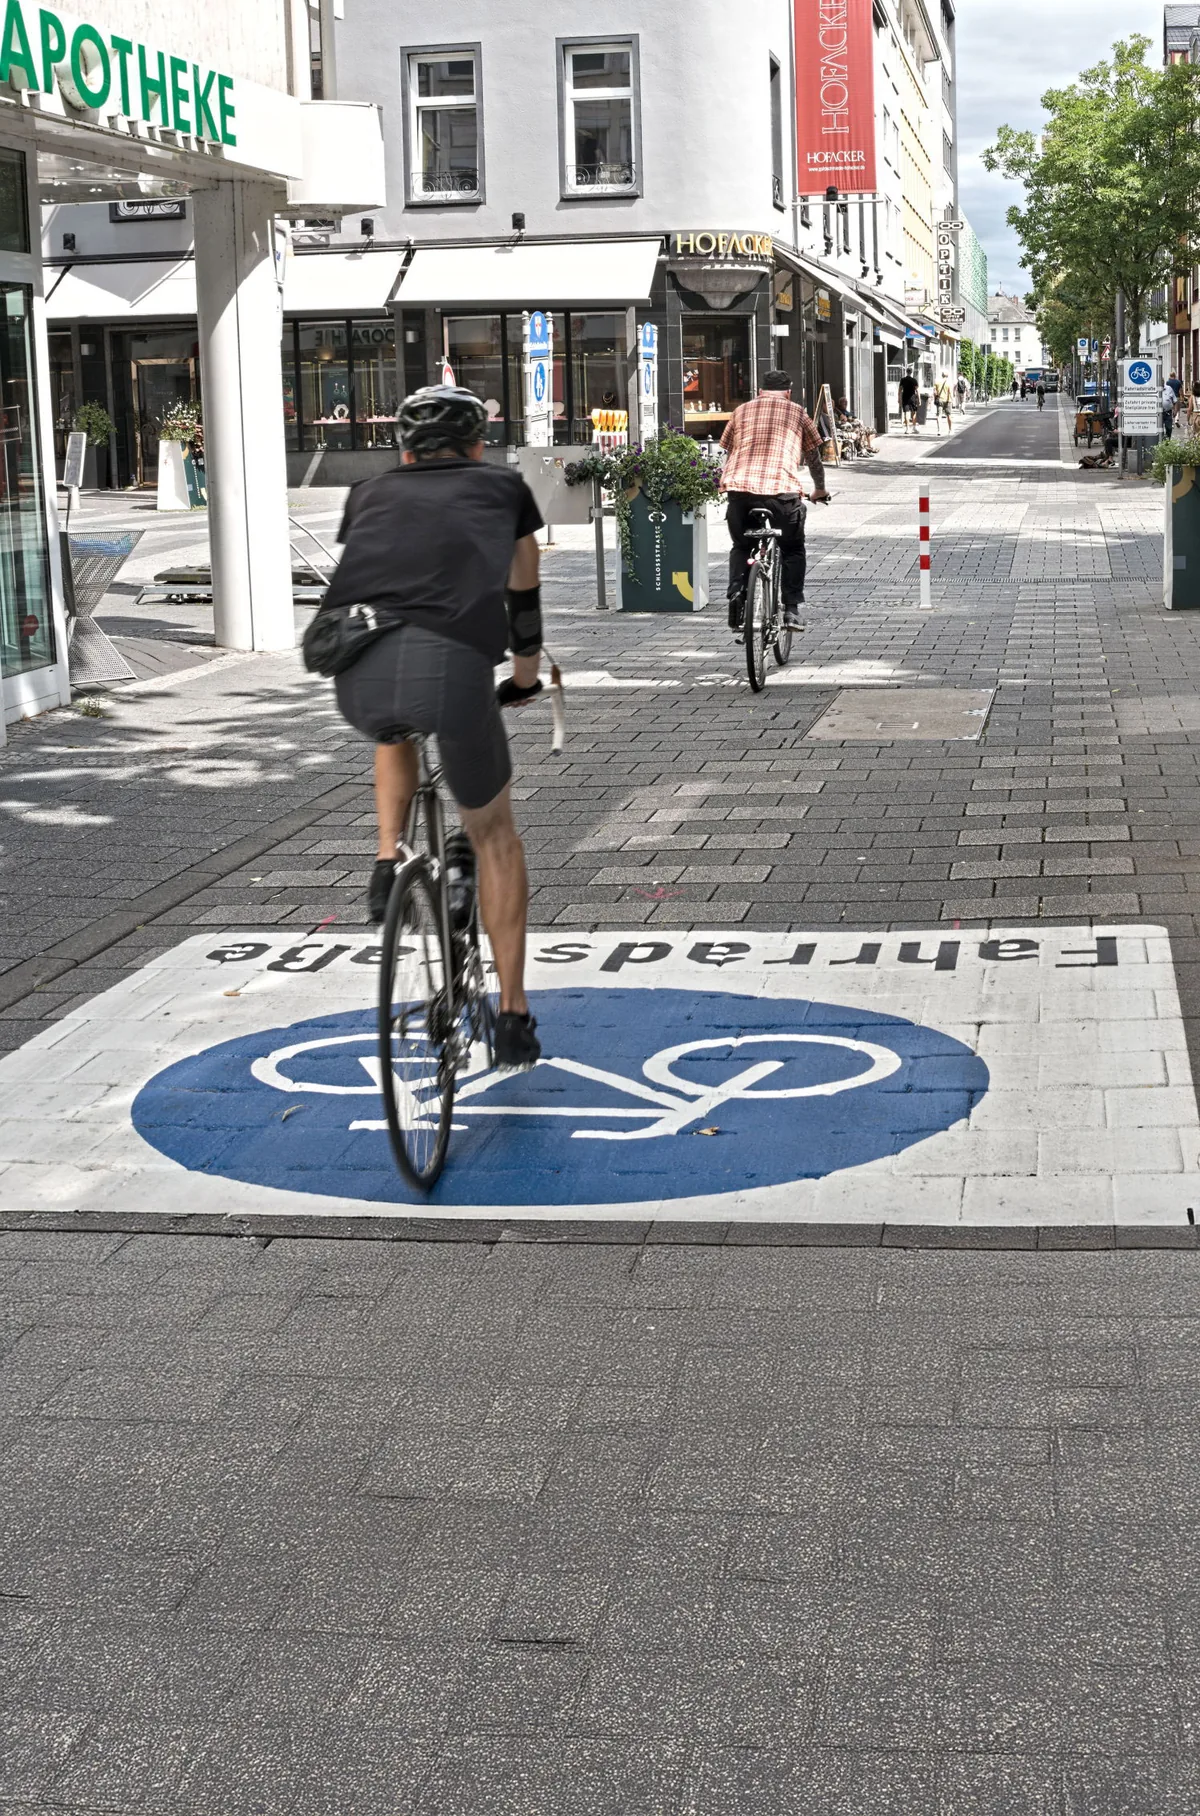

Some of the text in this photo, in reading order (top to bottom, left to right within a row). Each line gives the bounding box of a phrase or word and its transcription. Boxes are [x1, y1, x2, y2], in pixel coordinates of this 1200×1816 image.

[0, 0, 237, 147] APOTHEKE
[807, 150, 866, 164] HOFACKER
[939, 234, 951, 305] OPTIK
[205, 936, 1118, 973] Fahrradsaße
